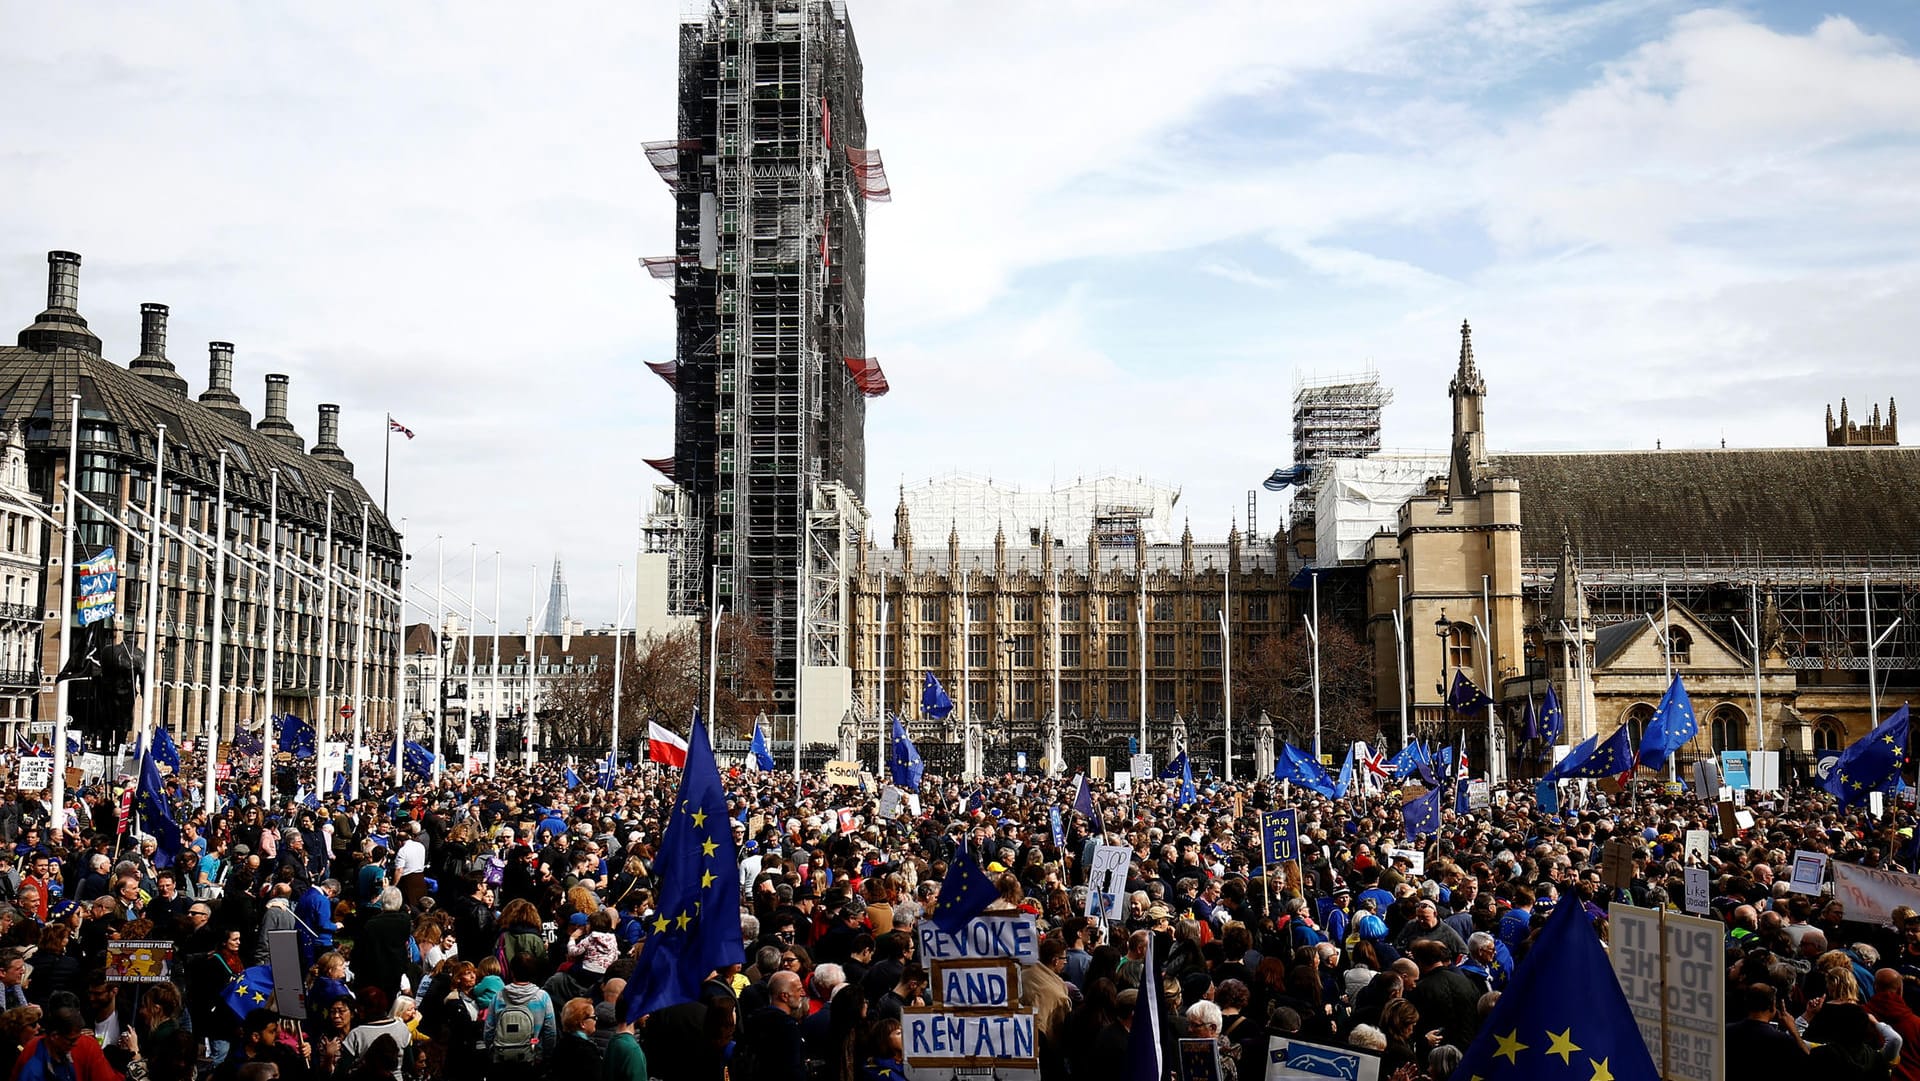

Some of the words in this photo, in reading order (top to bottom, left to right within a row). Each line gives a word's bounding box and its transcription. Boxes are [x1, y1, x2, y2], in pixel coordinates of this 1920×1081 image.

[1265, 815, 1280, 827] I'm
[1280, 817, 1289, 825] so
[1274, 826, 1287, 837] into
[1095, 849, 1127, 870] STOP
[1273, 840, 1290, 859] EU
[1089, 869, 1126, 893] BRIT
[1691, 874, 1698, 883] I
[920, 921, 1032, 957] REVOKE
[945, 971, 1007, 1006] AND
[912, 1015, 1034, 1060] REMAIN
